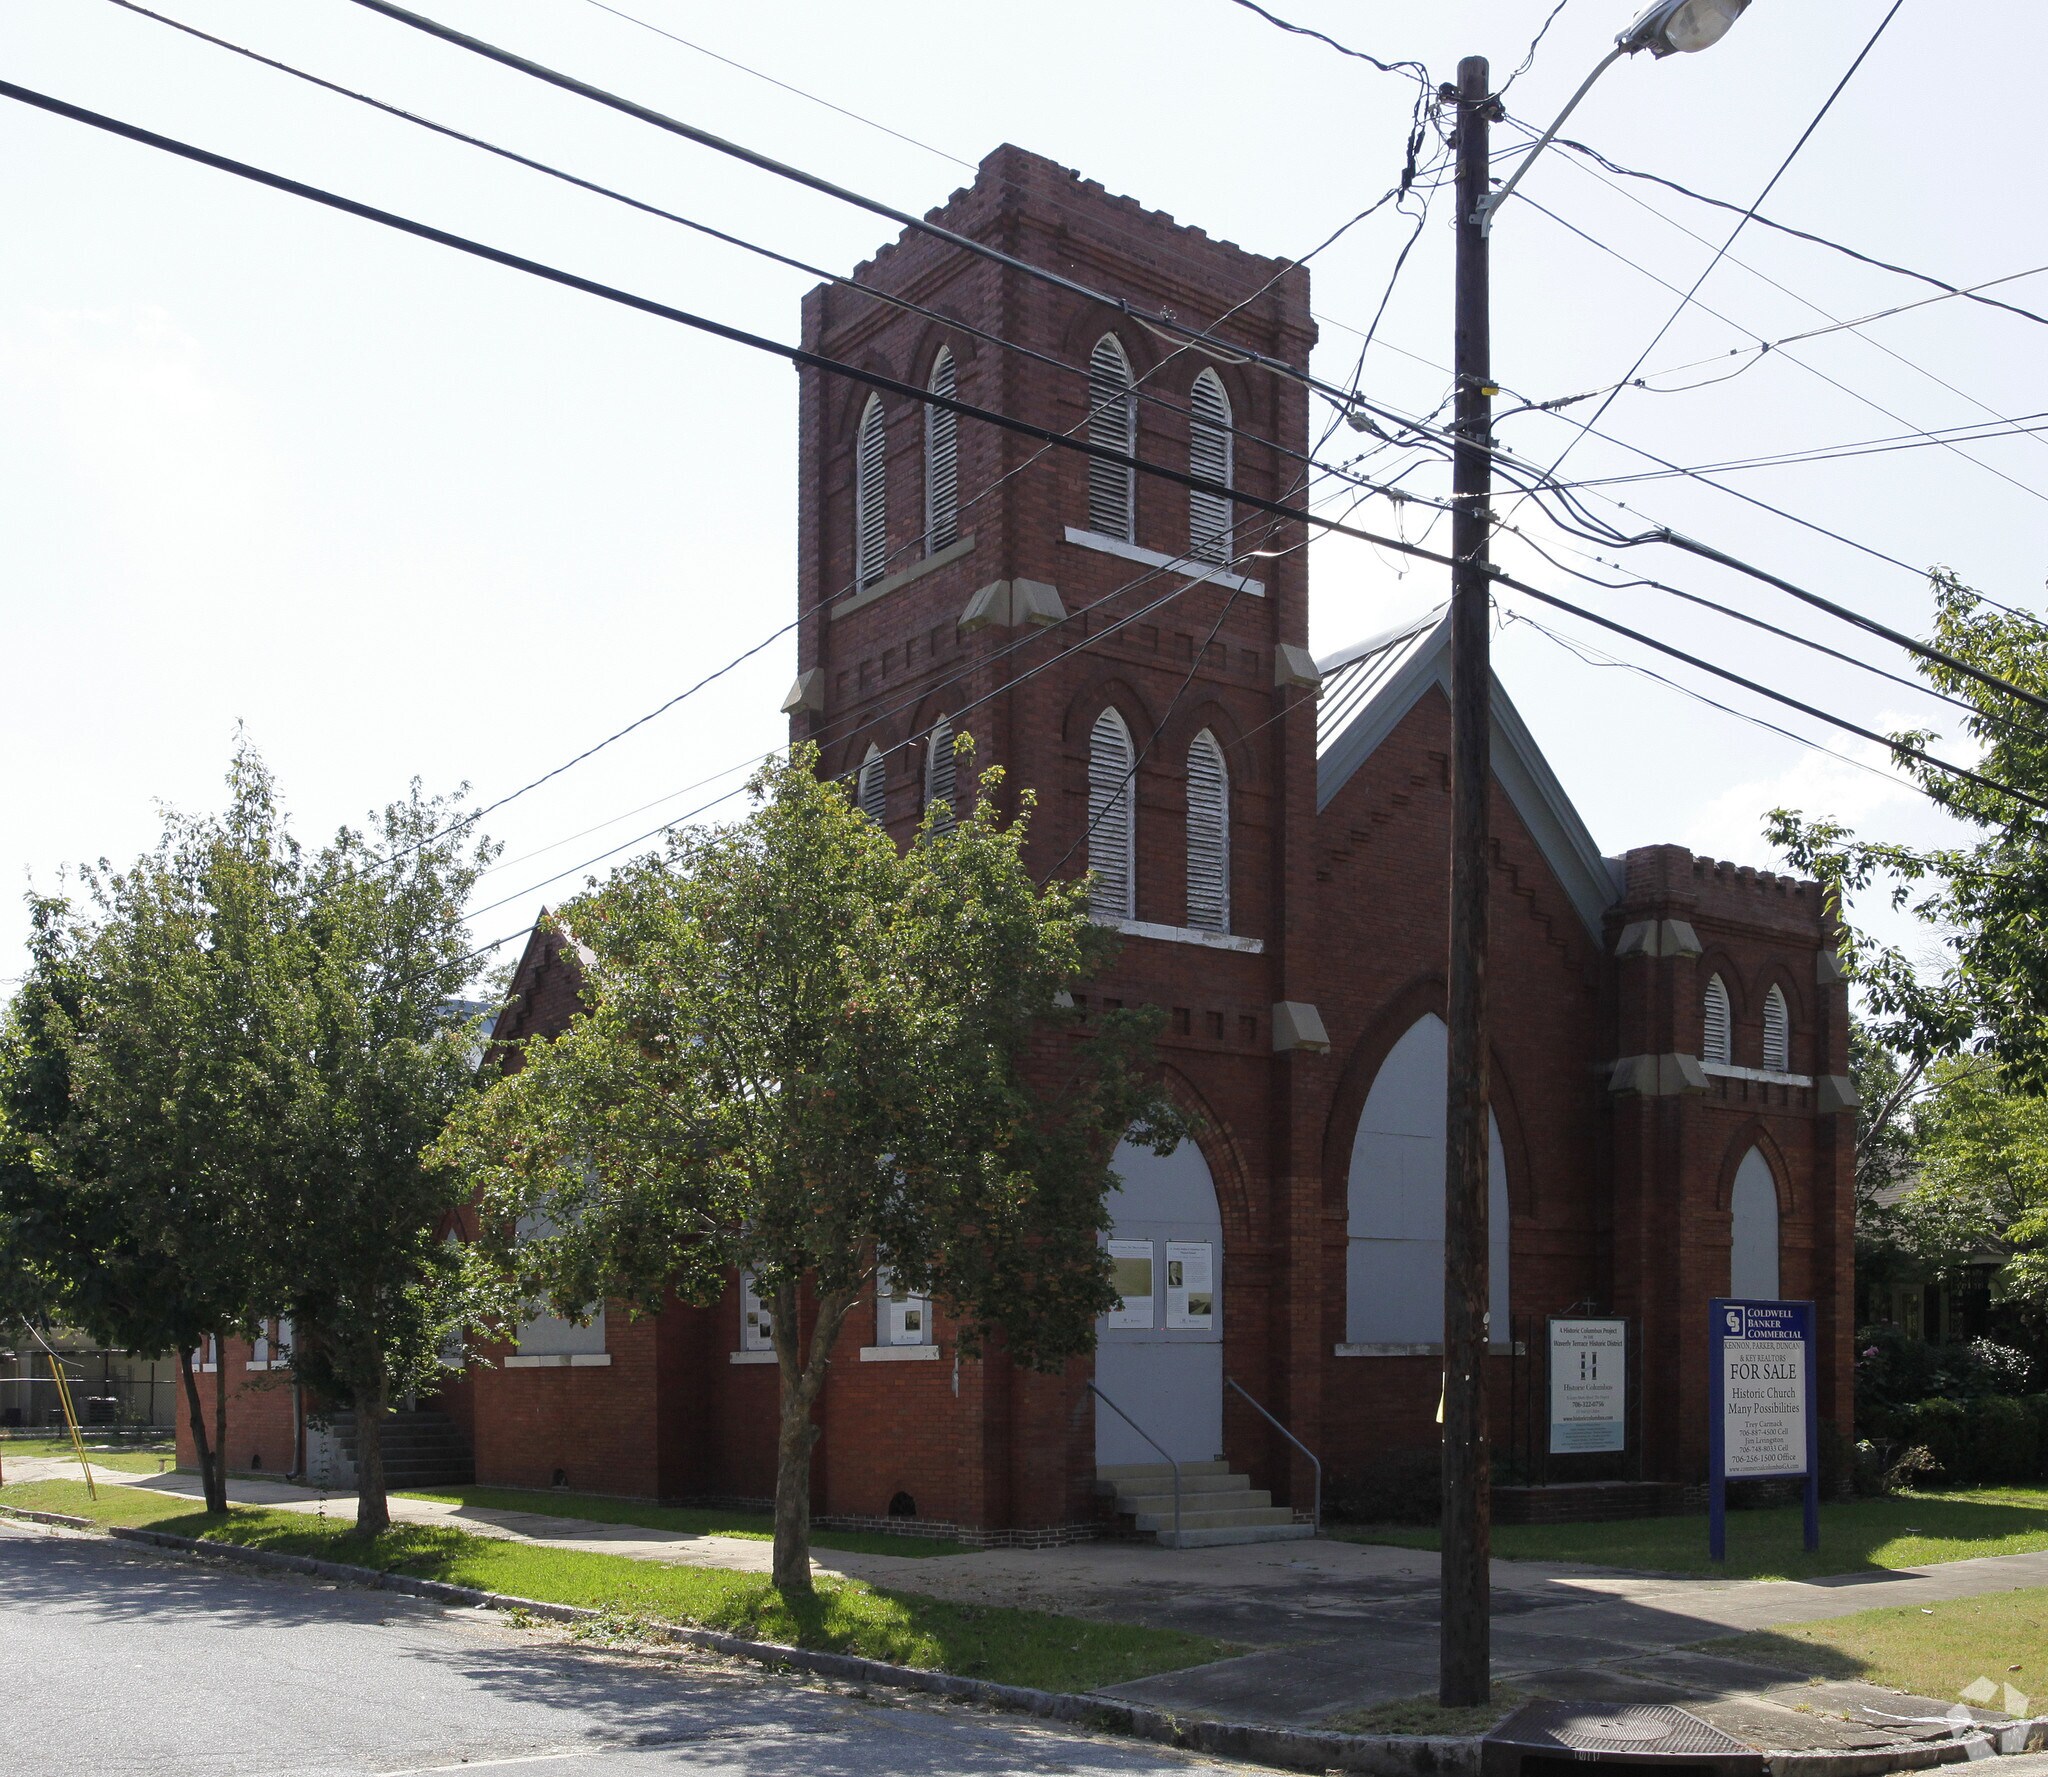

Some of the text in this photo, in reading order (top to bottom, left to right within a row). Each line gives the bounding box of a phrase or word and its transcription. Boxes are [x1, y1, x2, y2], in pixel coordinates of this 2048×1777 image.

[1747, 1308, 1793, 1318] COLDWELL
[1748, 1319, 1781, 1328] BANKER
[1747, 1329, 1802, 1339] COMMERCIAL
[1730, 1363, 1796, 1380] FOR SALE
[1732, 1387, 1796, 1398] Historic Church
[1728, 1402, 1800, 1417] Many Possibilities
[1745, 1437, 1754, 1446] Jim
[1777, 1453, 1796, 1461] Office
